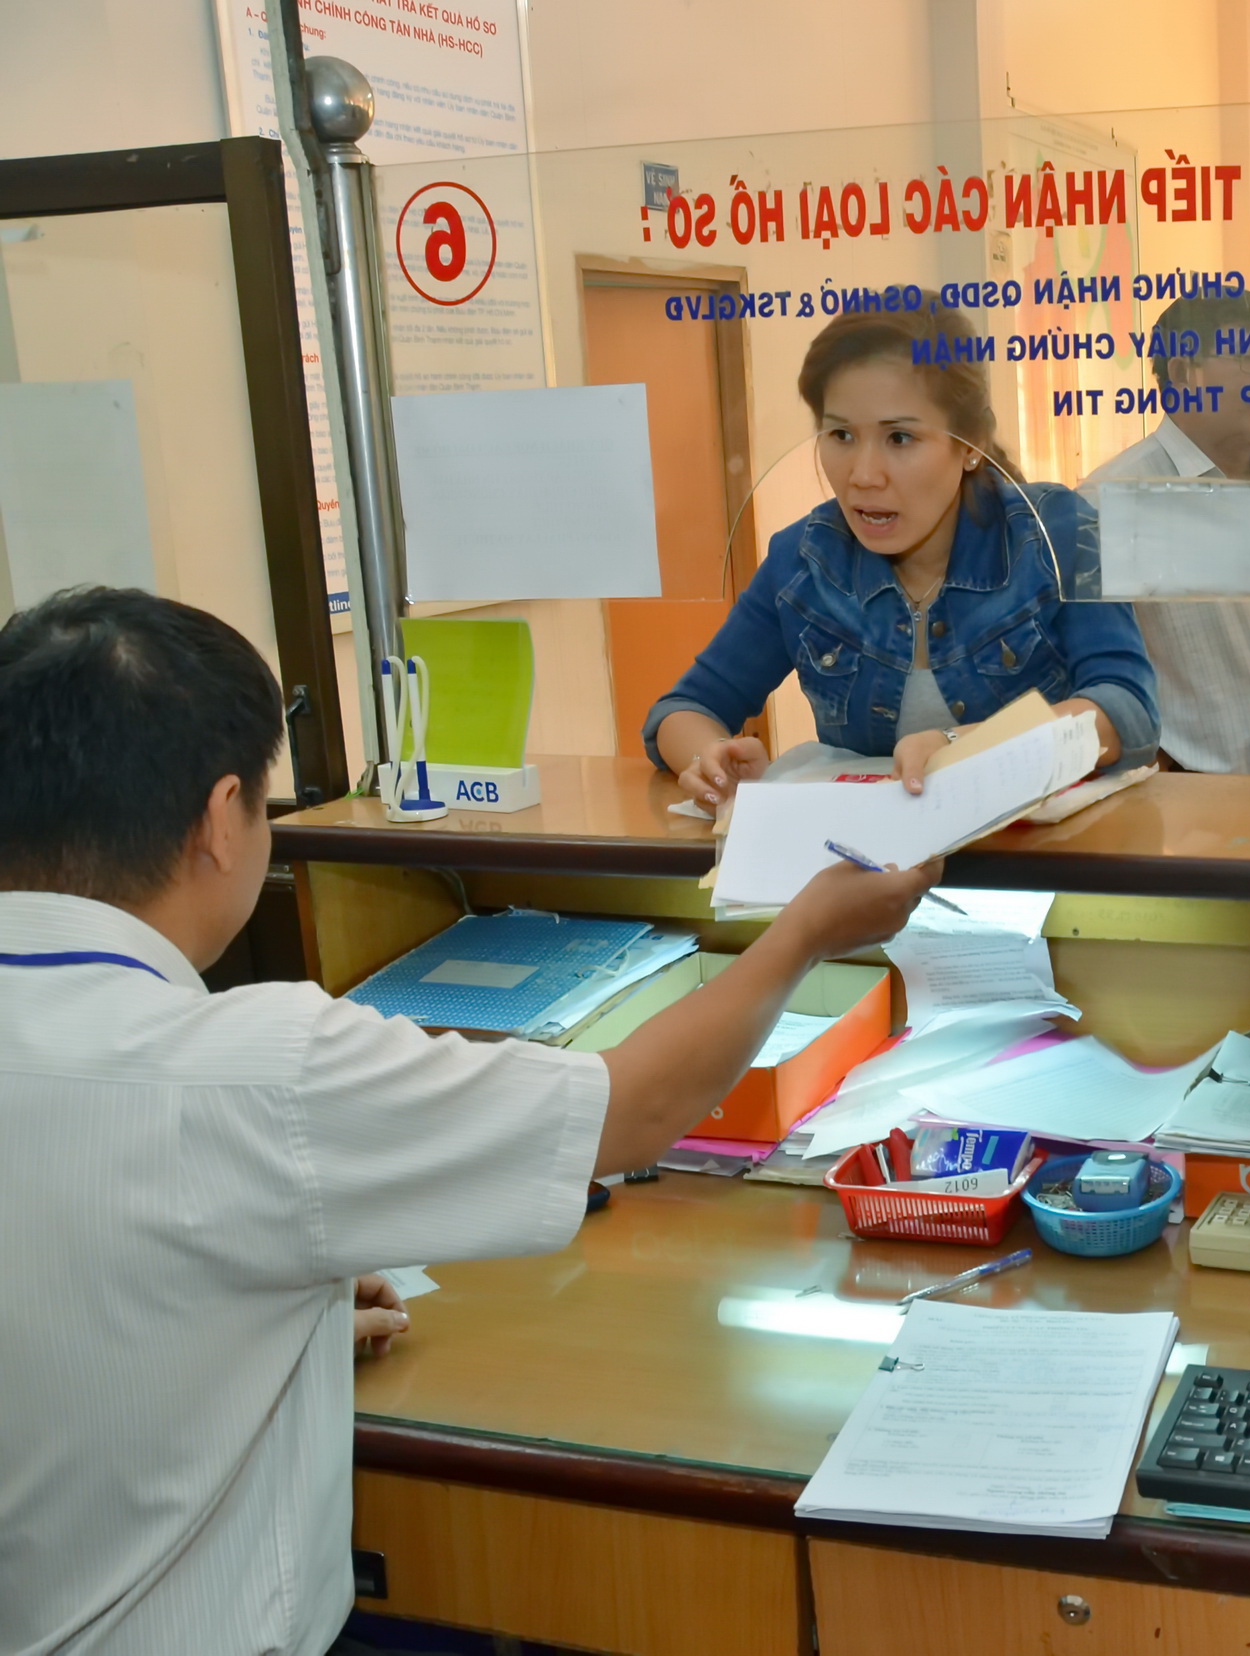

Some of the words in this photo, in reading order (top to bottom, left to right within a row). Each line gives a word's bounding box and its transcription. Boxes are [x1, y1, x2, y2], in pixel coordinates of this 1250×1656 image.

[354, 10, 386, 31] CÔNG
[413, 26, 436, 44] NHÀ
[438, 33, 483, 58] (HS-HCC)
[302, 352, 320, 364] rách
[456, 779, 500, 804] ACB
[960, 1130, 982, 1171] Tempo
